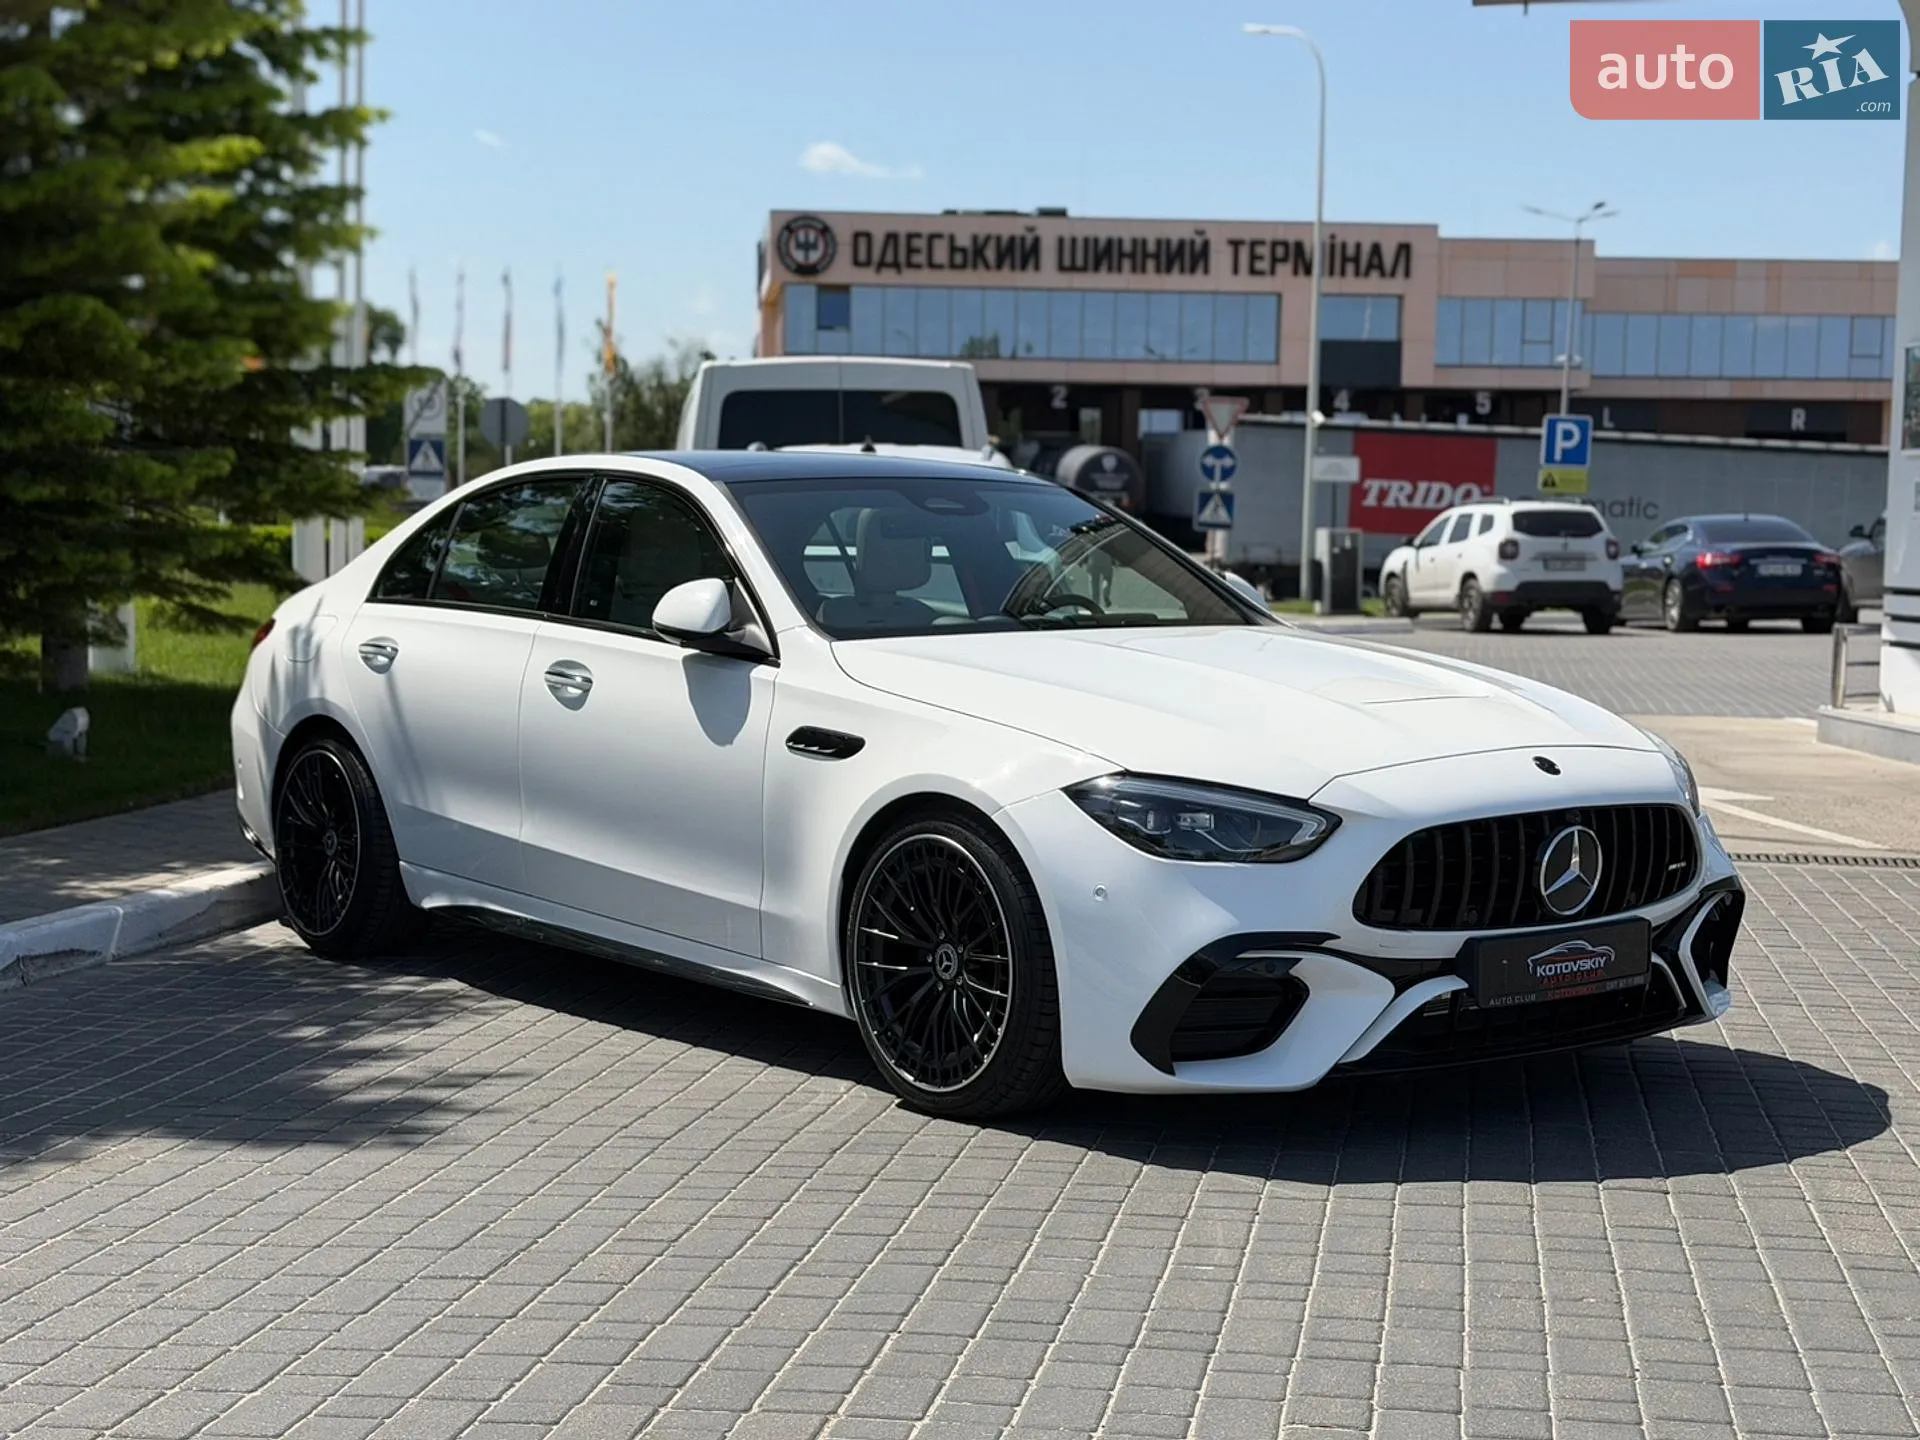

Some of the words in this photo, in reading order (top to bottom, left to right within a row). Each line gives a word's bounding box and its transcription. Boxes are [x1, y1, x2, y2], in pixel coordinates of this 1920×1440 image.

[852, 226, 1042, 275] ОДЕСЬКИЙ
[1057, 229, 1211, 276] ШИННИЙ
[1050, 385, 1067, 409] 2
[1333, 388, 1350, 412] 4
[1475, 391, 1492, 415] 5
[1603, 407, 1615, 428] L
[1791, 407, 1806, 431] R
[1554, 420, 1581, 461] P
[1536, 957, 1607, 977] KOTOVSKIY
